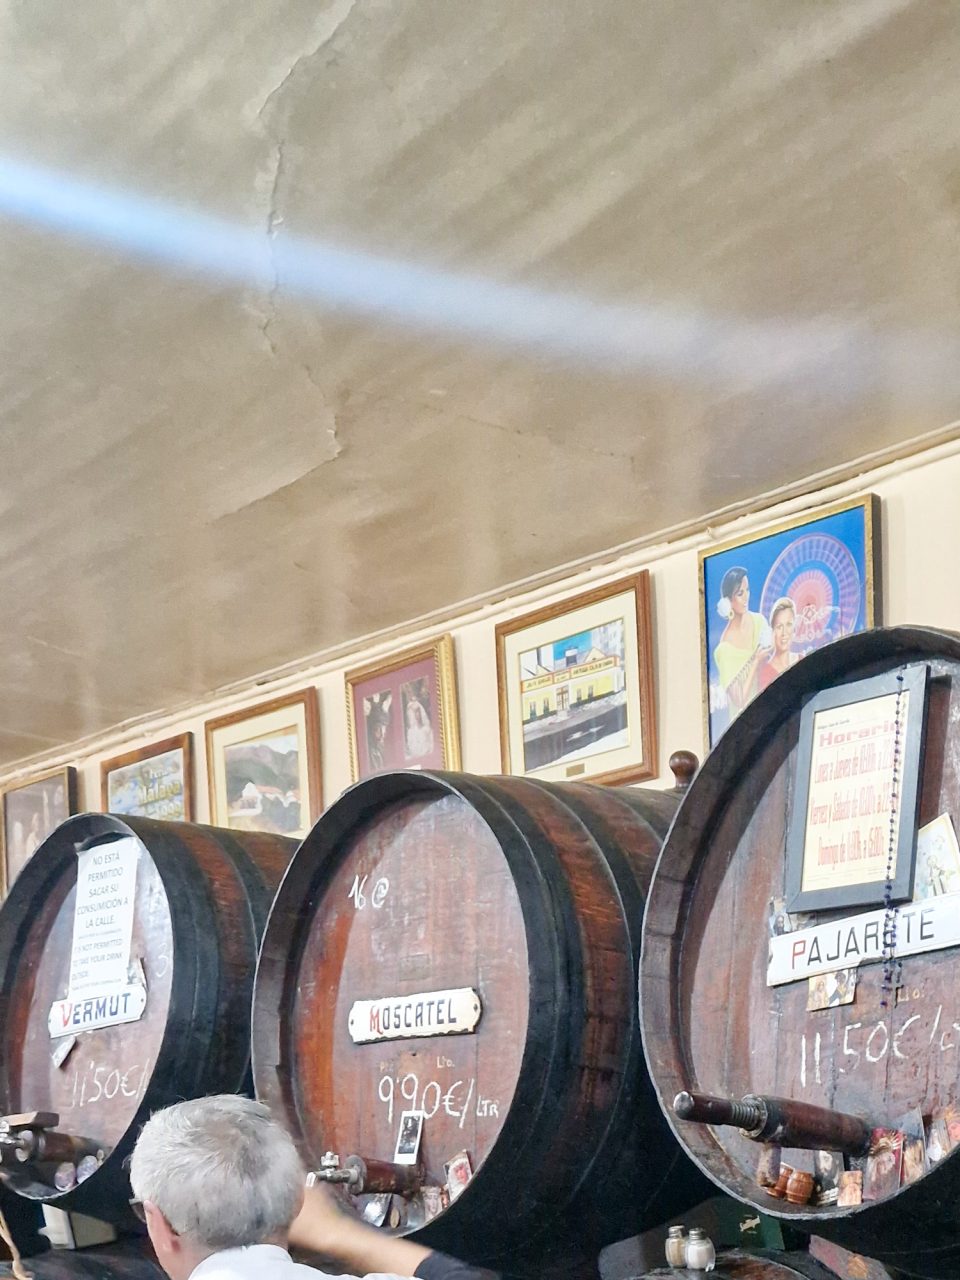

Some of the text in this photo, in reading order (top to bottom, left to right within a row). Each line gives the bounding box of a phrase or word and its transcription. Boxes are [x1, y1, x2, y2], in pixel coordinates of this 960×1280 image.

[92, 855, 103, 866] NO
[87, 866, 124, 882] PERMITIDO
[60, 992, 131, 1027] VERMUT
[369, 997, 457, 1035] MOSCATEL
